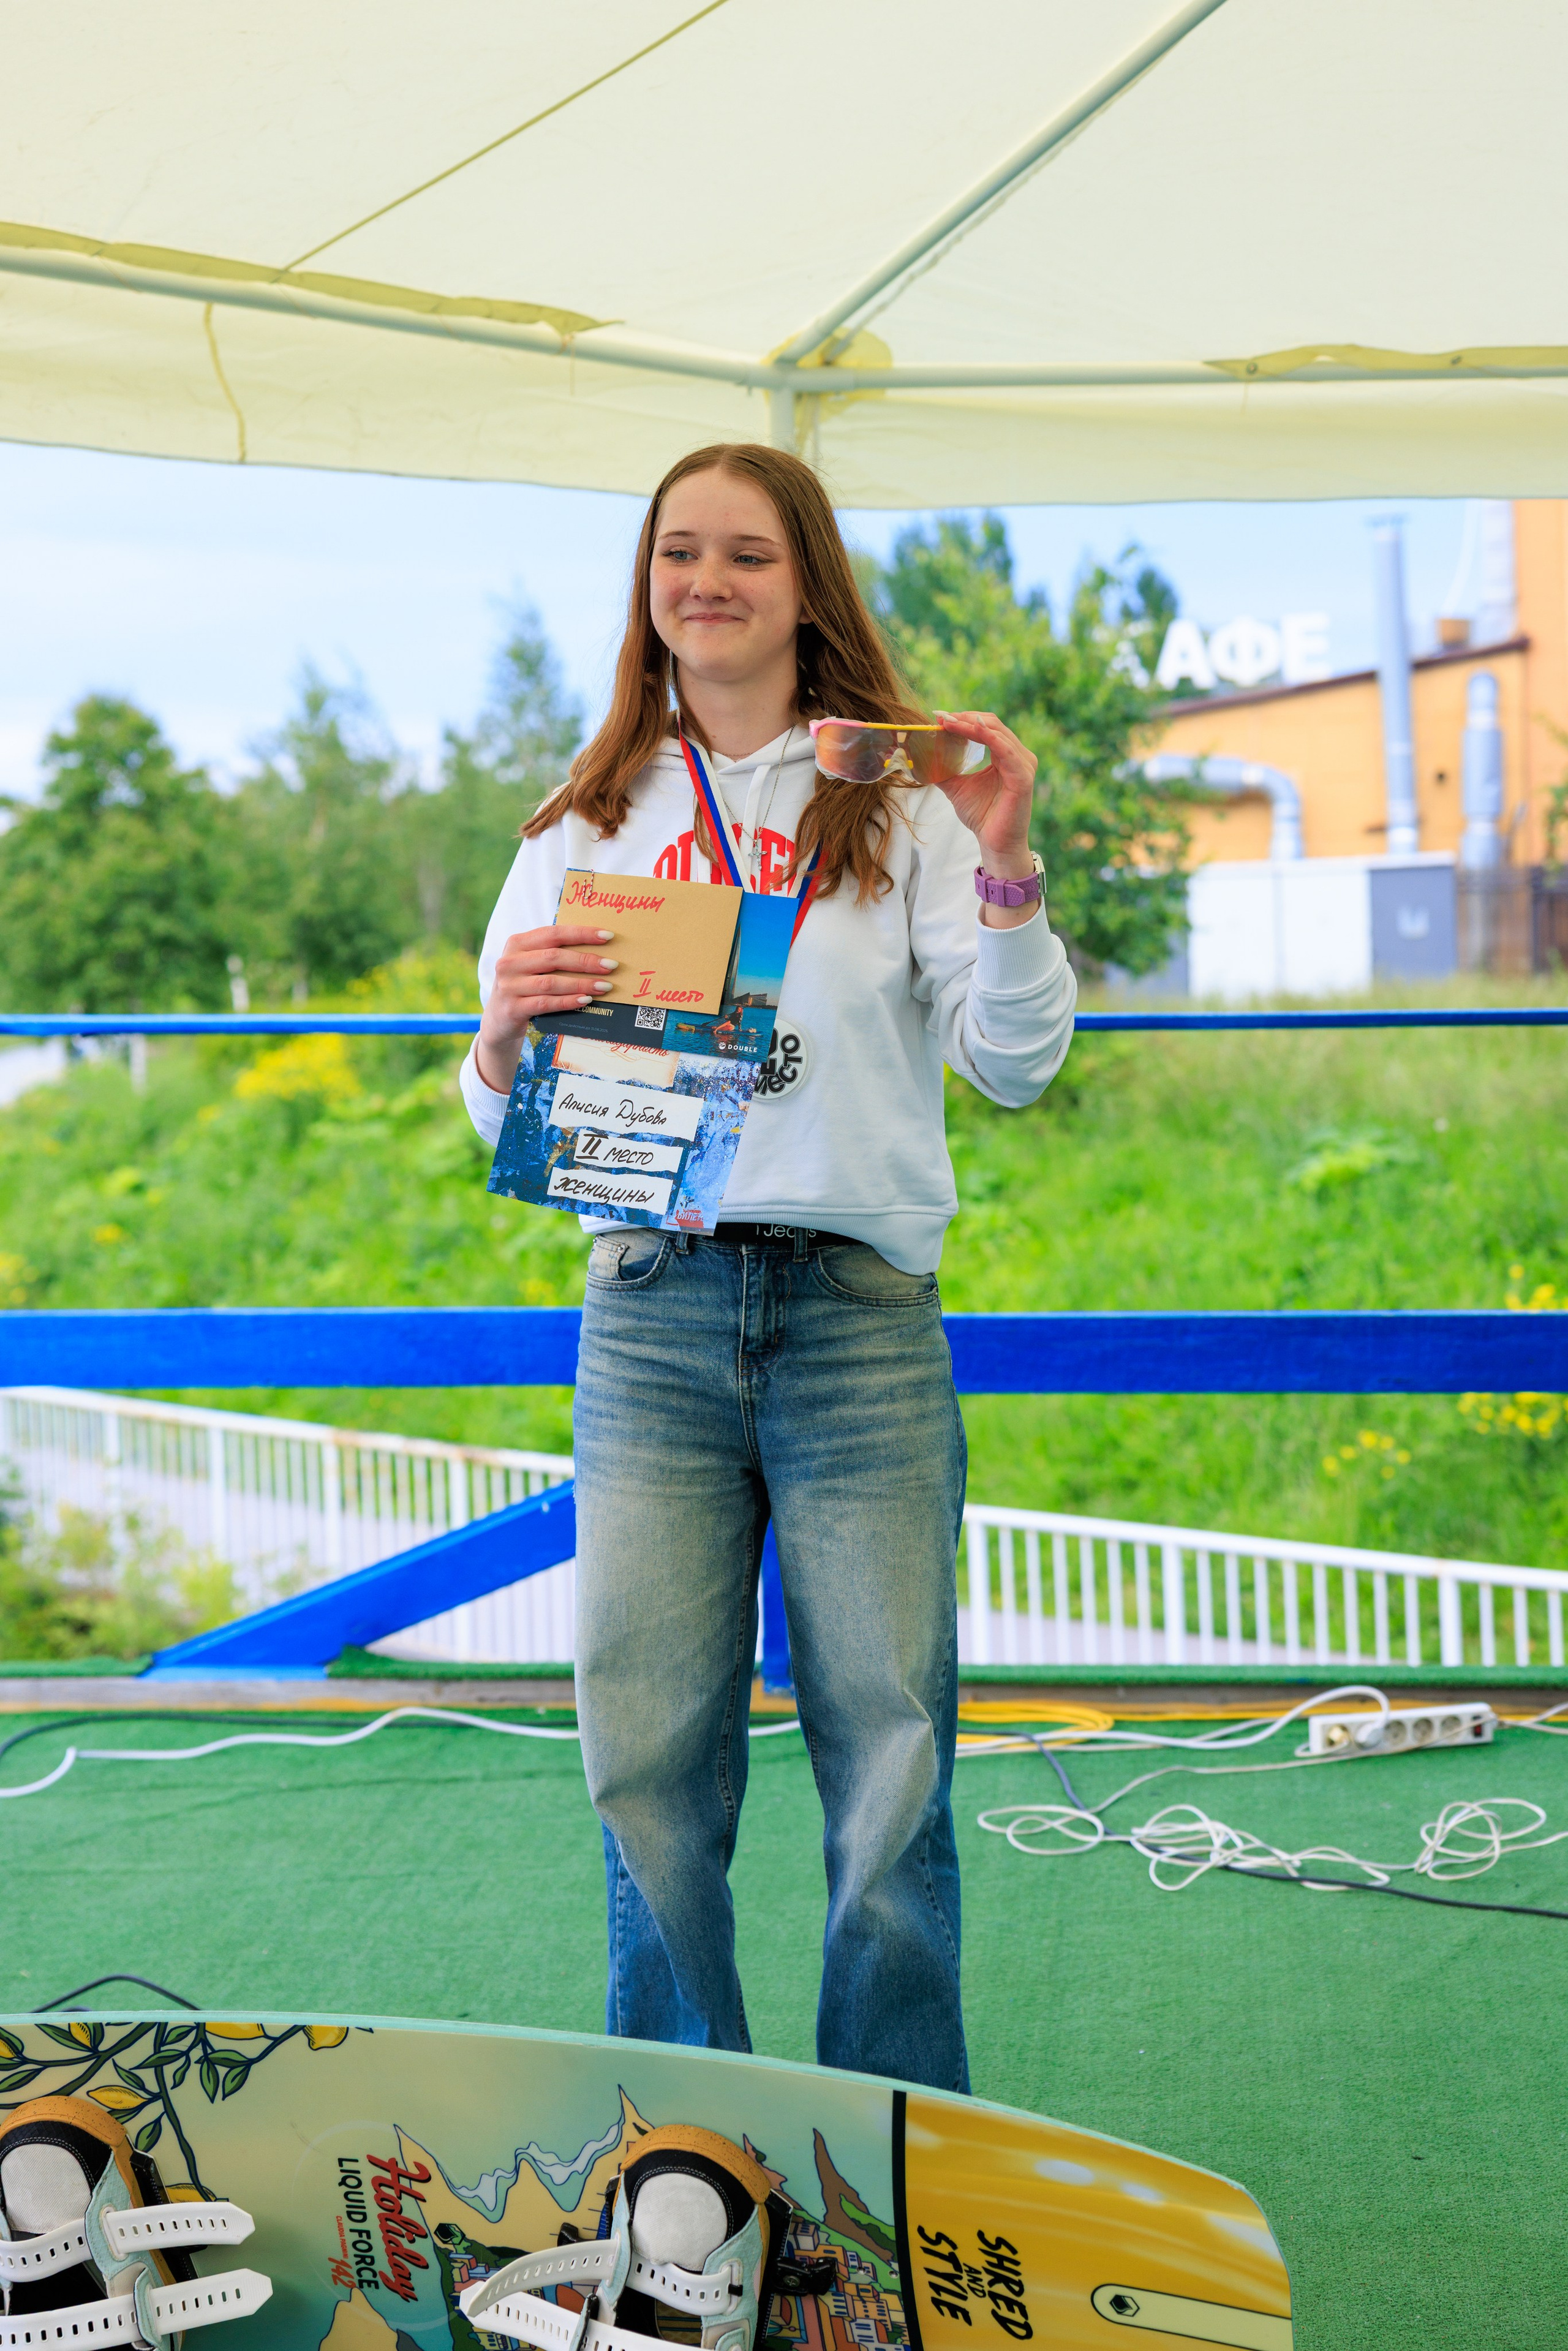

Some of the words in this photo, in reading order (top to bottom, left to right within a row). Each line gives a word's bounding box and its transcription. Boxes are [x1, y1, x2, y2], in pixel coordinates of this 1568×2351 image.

[566, 881, 665, 914] Женщины
[633, 971, 656, 998] II
[656, 990, 704, 1003] место
[559, 1093, 609, 1117] Алисия
[616, 1099, 666, 1127] Дубова
[576, 1134, 609, 1160] II
[763, 1224, 816, 1238] Jeas
[337, 2157, 368, 2224] LIQUID
[336, 2216, 345, 2238] CLAUDIA
[366, 2154, 431, 2303] Holiday
[328, 2257, 356, 2289] 142
[349, 2228, 379, 2290] FORCE
[918, 2225, 972, 2326] STYLE
[963, 2263, 986, 2298] AND
[977, 2230, 1033, 2340] SHRED
